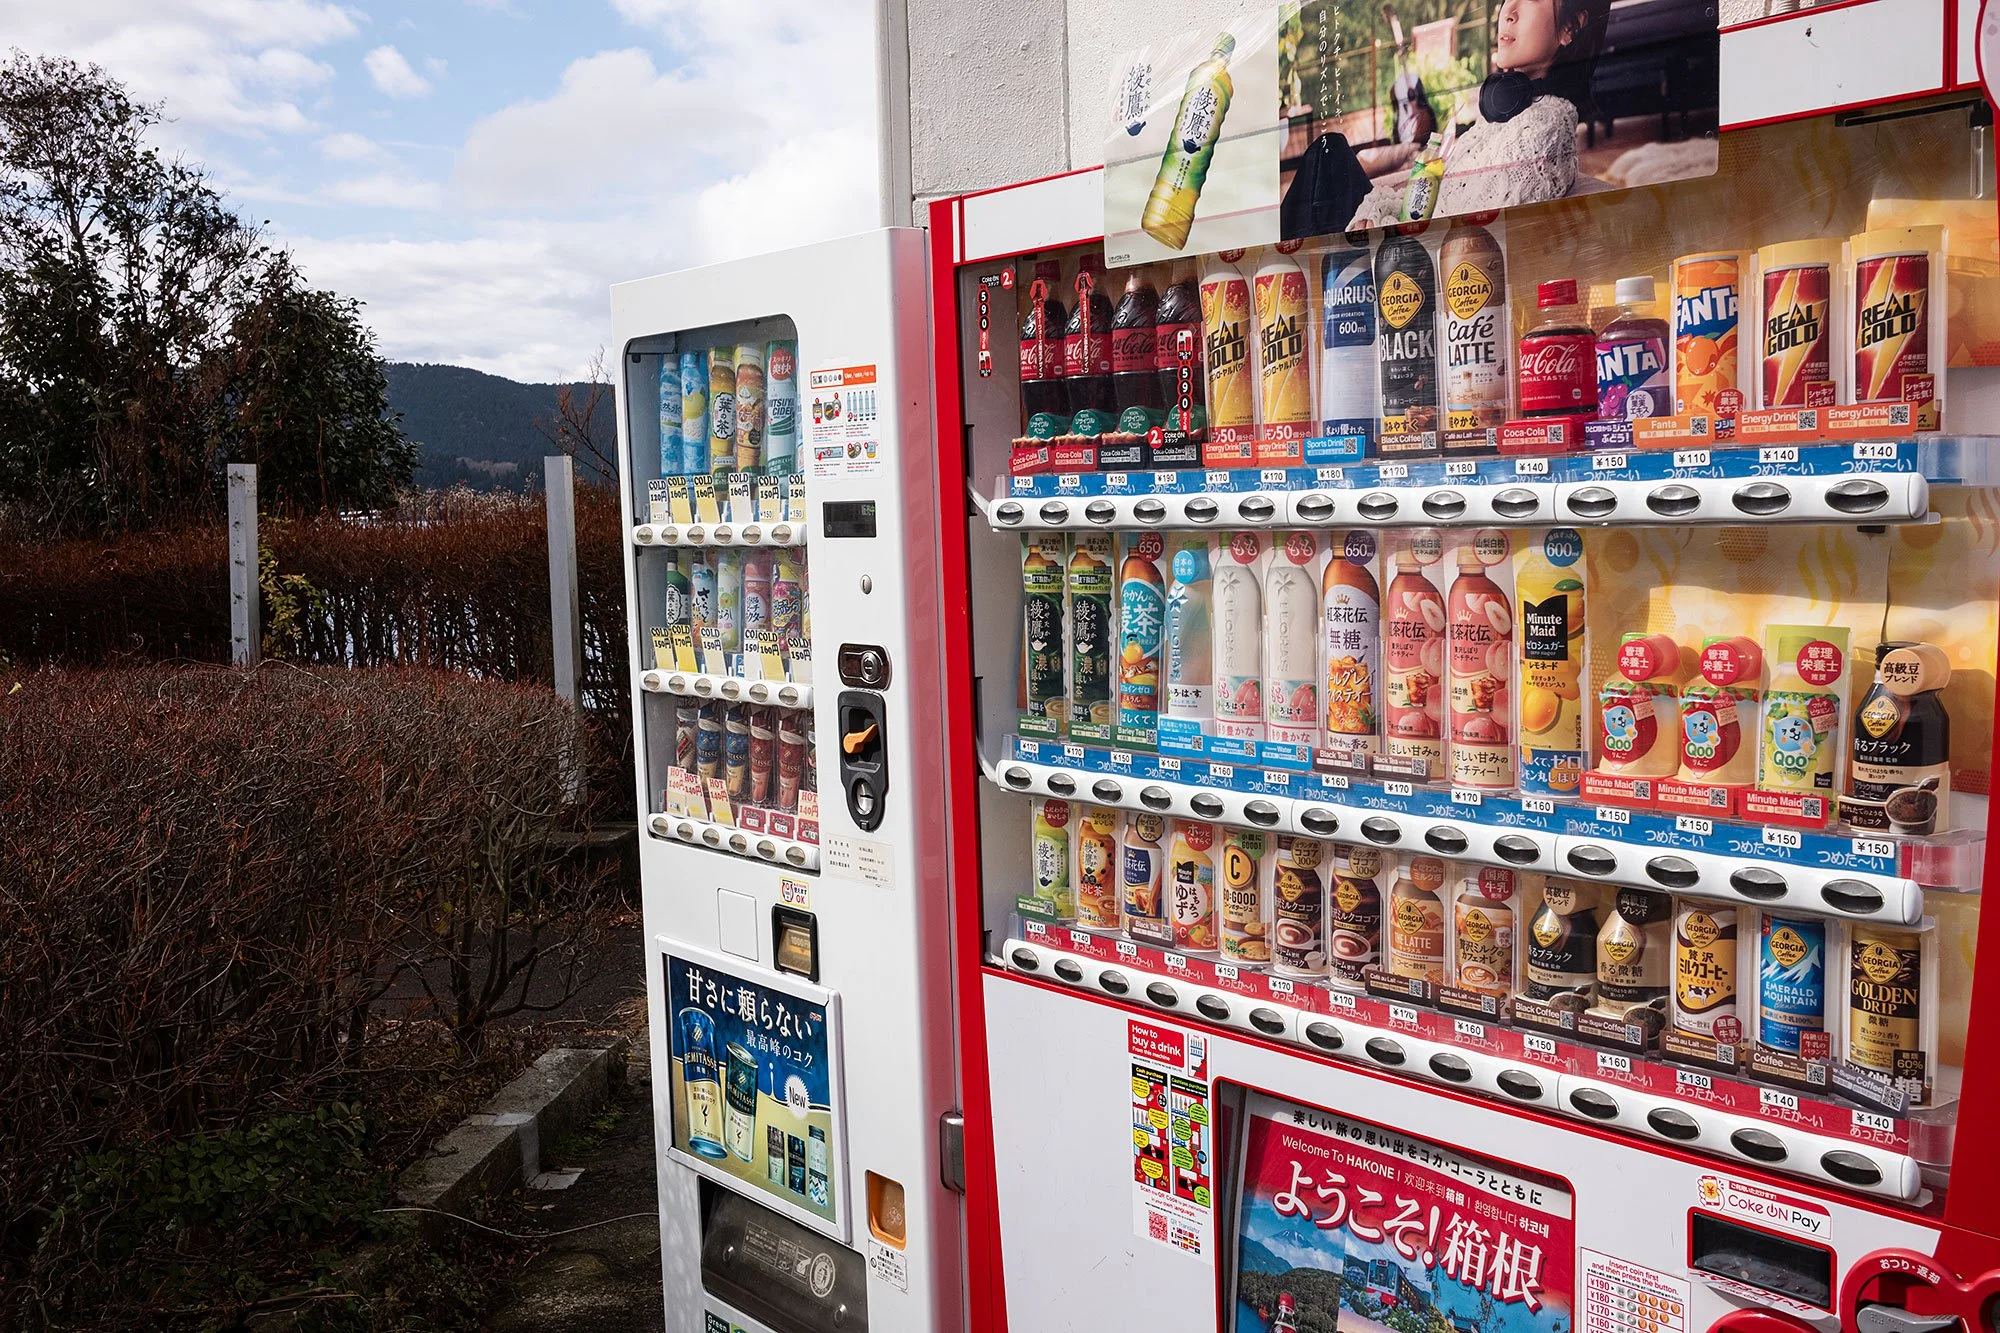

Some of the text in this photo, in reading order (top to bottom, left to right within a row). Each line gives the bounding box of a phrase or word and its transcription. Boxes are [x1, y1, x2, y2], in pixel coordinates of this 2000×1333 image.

[1319, 9, 1332, 154] 自分のリズムでいこう。
[1448, 284, 1489, 297] GEORGIA
[1382, 294, 1420, 306] GEORGIA
[1454, 298, 1479, 308] Coffee
[1861, 292, 1916, 329] REAL
[1767, 302, 1817, 335] REAL
[1339, 321, 1367, 335] 600ml
[1448, 315, 1494, 342] Café
[1861, 313, 1916, 349] GOLD
[1381, 329, 1434, 362] BLACK
[1767, 322, 1818, 356] GOLD
[1449, 342, 1496, 367] LATTE
[1828, 406, 1889, 420] Energy Drink
[1651, 420, 1677, 429] Fanta
[1381, 434, 1421, 444] Black Coffee
[1503, 428, 1545, 438] Coca-Cola
[1307, 439, 1344, 448] Sports Drink
[1763, 450, 1795, 461] ¥140
[1858, 446, 1893, 457] ¥140
[1596, 457, 1623, 467] ¥150
[1679, 454, 1706, 464] ¥110
[1519, 462, 1544, 472] ¥140
[729, 473, 749, 483] COLD
[1062, 477, 1078, 485] ¥190
[1319, 470, 1341, 479] ¥180
[668, 477, 687, 486] COLD
[759, 476, 779, 487] COLD
[670, 488, 688, 499] 160円
[730, 485, 749, 497] 160円
[760, 488, 779, 499] 150円
[1476, 540, 1505, 549] 山梨白桃
[1076, 601, 1092, 639] 綾鷹
[1526, 614, 1562, 625] Minute
[672, 625, 690, 634] COLD
[701, 628, 720, 638] COLD
[1530, 625, 1556, 637] Maid
[674, 635, 692, 648] 170円
[703, 639, 721, 651] 150円
[1329, 629, 1361, 650] 無糖
[1526, 641, 1564, 651] ゼロシュガー
[1707, 650, 1729, 661] 管理
[1808, 647, 1833, 660] 管理
[1529, 662, 1558, 670] レモネード
[1703, 662, 1734, 673] 栄養士
[1800, 660, 1839, 672] 栄養士
[1884, 663, 1919, 675] 高級豆
[1886, 674, 1917, 684] ブレンド
[1606, 737, 1632, 750] Qoo
[1687, 743, 1714, 758] Qoo
[1773, 751, 1807, 768] Qoo
[709, 778, 724, 789] HOT
[1387, 784, 1409, 793] ¥170
[1658, 784, 1709, 796] Minute Maid
[710, 791, 728, 802] 140円
[1525, 802, 1551, 811] ¥160
[1496, 812, 1548, 828] つめた〜い
[1600, 811, 1627, 821] ¥150
[1680, 819, 1709, 832] ¥150
[1645, 829, 1705, 847] つめた〜い
[1767, 833, 1797, 845] ¥150
[1857, 842, 1889, 854] ¥150
[1817, 851, 1885, 870] つめた〜い
[1485, 869, 1509, 883] 国産
[1485, 881, 1509, 893] 牛乳
[1176, 886, 1188, 919] ゆず
[1686, 923, 1717, 935] GEORGIA
[1405, 935, 1432, 949] LATTE
[1771, 940, 1804, 953] GEORGIA
[1462, 952, 1497, 964] カフェオレ
[1689, 949, 1714, 962] 贅沢
[1863, 956, 1899, 969] GEORGIA
[1680, 959, 1728, 982] ミルクコーヒー
[1766, 981, 1814, 998] EMERALD
[1851, 978, 1918, 1005] GOLDEN
[686, 967, 812, 1040] 甘さに頼らない
[1764, 990, 1817, 1007] MOUNTAIN
[1515, 1002, 1560, 1018] Black Coffee
[1863, 1000, 1897, 1014] DRIP
[1868, 1015, 1889, 1028] 微糖
[1132, 1025, 1158, 1038] How to
[1458, 1022, 1481, 1035] ¥160
[746, 1029, 813, 1069] 最高峰のコク
[1132, 1034, 1181, 1056] buy a drink
[1527, 1037, 1552, 1050] ¥150
[1600, 1056, 1627, 1068] ¥160
[1753, 1053, 1784, 1067] Coffee
[1897, 1059, 1923, 1070] 60%
[1679, 1072, 1708, 1085] ¥130
[1903, 1068, 1917, 1076] オフ
[788, 1085, 806, 1109] New
[1763, 1092, 1794, 1106] ¥140
[1857, 1114, 1890, 1128] ¥140
[1282, 1134, 1395, 1179] Welcome To HAKONE
[1292, 1109, 1544, 1205] 楽しい旅の思い出をコカ・コーラとともに
[1403, 1173, 1466, 1207] 欢迎来到箱根
[1474, 1199, 1550, 1239] 환영합니다 하코네
[1728, 1194, 1820, 1232] Coke ON Pay
[1272, 1160, 1543, 1308] ようこそ!箱根
[1609, 1260, 1659, 1282] Insert coin first
[1879, 1258, 1941, 1284] おつり・返却
[1590, 1278, 1609, 1291] ¥190
[1592, 1262, 1679, 1295] and then press the button.
[1590, 1291, 1609, 1304] ¥180
[1590, 1304, 1609, 1316] ¥170
[707, 1314, 728, 1332] Green
[1590, 1316, 1609, 1329] ¥160
